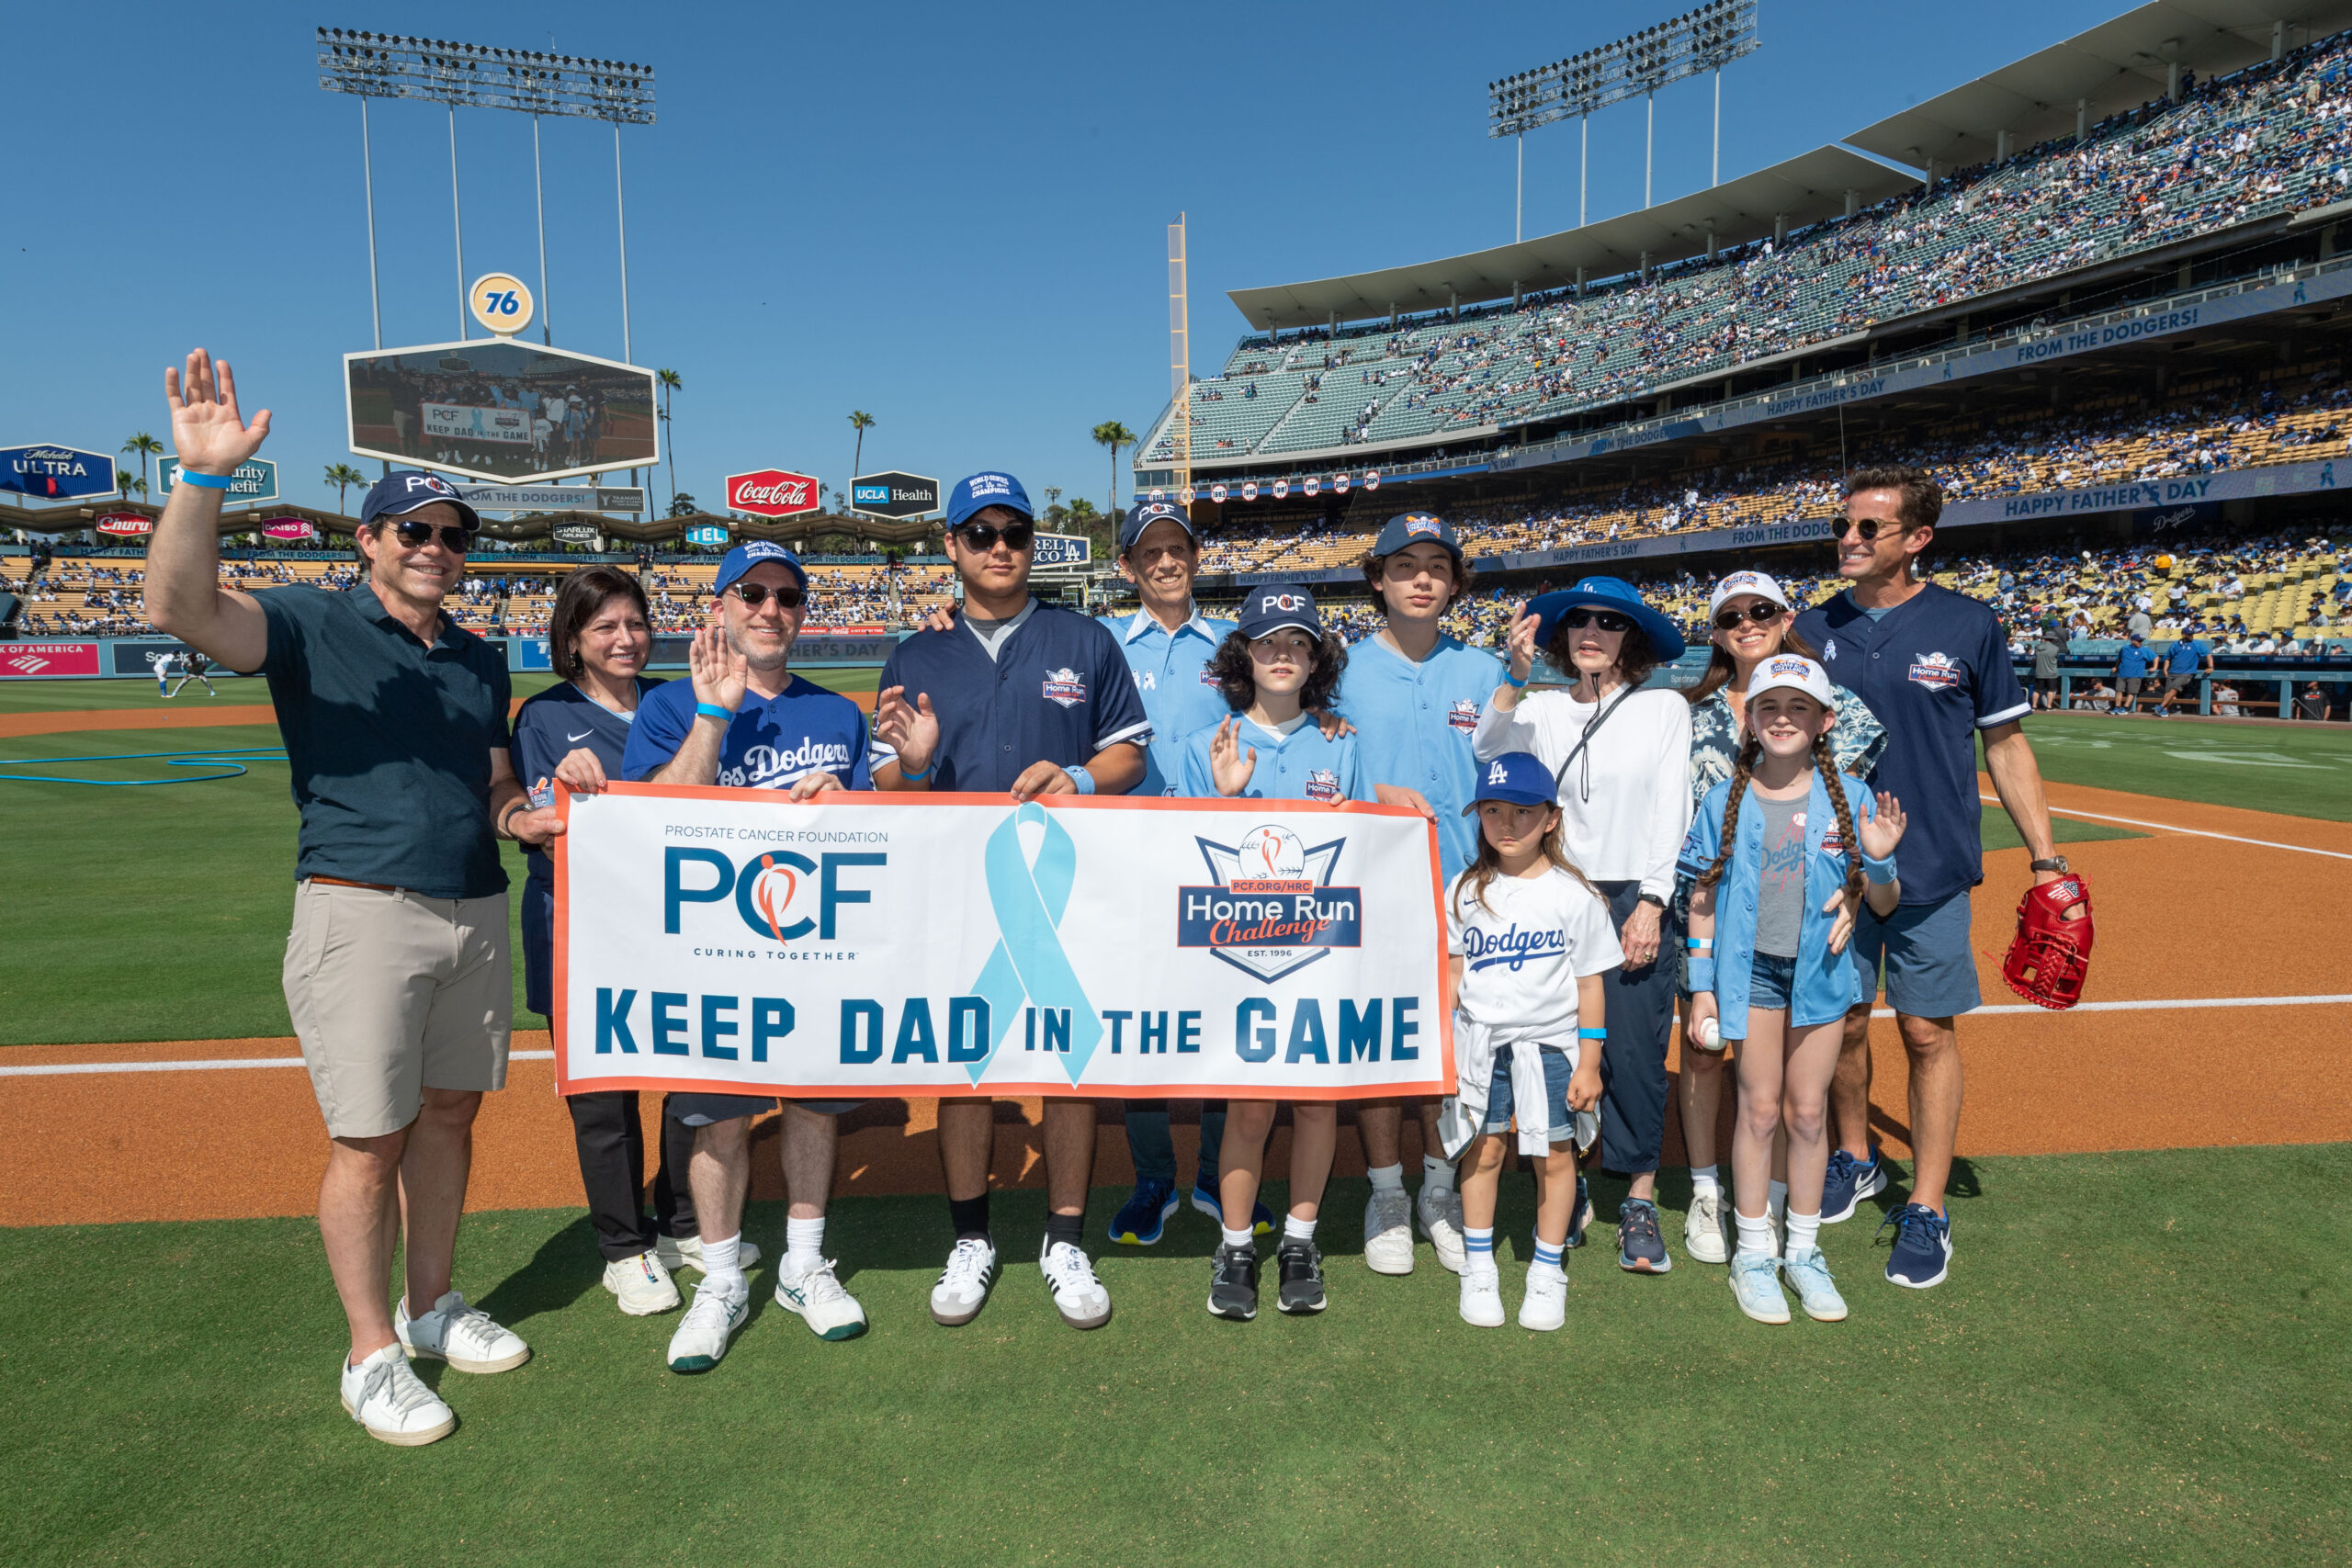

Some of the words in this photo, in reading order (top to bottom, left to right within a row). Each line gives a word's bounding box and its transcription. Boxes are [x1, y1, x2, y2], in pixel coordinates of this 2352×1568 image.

[485, 290, 521, 316] 76
[2018, 340, 2063, 362] FROM
[2067, 330, 2098, 350] THE
[2103, 309, 2199, 342] DODGERS!
[1767, 397, 1804, 416] HAPPY
[1805, 386, 1858, 408] FATHER'S
[1860, 379, 1885, 395] DAY
[433, 409, 459, 422] PCF
[426, 423, 450, 434] KEEP
[454, 427, 474, 437] DAD
[503, 431, 529, 441] GAME
[24, 449, 74, 460] Michelob
[13, 460, 87, 477] ULTRA
[232, 466, 266, 482] urity
[226, 480, 260, 493] nefit
[405, 476, 456, 497] PCF
[969, 475, 989, 488] WORLD
[1335, 479, 1349, 489] 2020
[735, 479, 810, 506] Coca-Cola
[857, 489, 887, 501] UCLA
[892, 489, 933, 502] Health
[972, 487, 1011, 499] CHAMPIONS
[1274, 485, 1287, 494] 1981
[495, 492, 518, 502] THE
[521, 492, 585, 504] DODGERS!
[2005, 495, 2065, 517] HAPPY
[2071, 483, 2160, 510] FATHER'S
[2166, 479, 2212, 500] DAY
[1137, 502, 1175, 522] PCF
[2154, 505, 2196, 533] Dodgers
[99, 516, 151, 531] Churu
[265, 524, 298, 532] DAISO
[691, 527, 724, 542] TEL
[1733, 530, 1766, 545] FROM
[1768, 526, 1790, 541] THE
[1793, 522, 1830, 537] DODG
[81, 547, 115, 556] HAPPY
[247, 550, 275, 559] FROM
[278, 551, 295, 559] THE
[297, 550, 346, 559] DODGERS!
[1064, 539, 1080, 562] LA
[1553, 548, 1580, 563] HAPPY
[1581, 546, 1619, 560] FATHER'S
[1621, 543, 1640, 556] DAY
[558, 554, 602, 563] DODGERS!
[840, 556, 879, 564] DODGERS!
[1240, 574, 1268, 584] HAPPY
[1310, 570, 1329, 581] DAY
[1261, 592, 1306, 615] PCF
[26, 645, 84, 653] AMERICA
[845, 642, 879, 657] DAY
[1912, 667, 1940, 677] Home
[1940, 670, 1958, 680] Run
[1046, 683, 1070, 692] Home
[744, 736, 851, 783] Dodgers
[1487, 760, 1509, 785] LA
[1307, 783, 1330, 794] Home
[664, 824, 735, 840] PROSTATE
[739, 828, 795, 843] CANCER
[798, 829, 888, 844] FOUNDATION
[1760, 840, 1804, 872] Dodg
[664, 845, 888, 943] PCF
[1232, 881, 1311, 893] PCF.ORG/HRC
[1187, 894, 1283, 921] Home
[1294, 895, 1355, 922] Run
[1209, 917, 1331, 946] Challenge
[694, 947, 757, 959] CURING
[1463, 922, 1566, 973] Dodgers
[594, 986, 797, 1063] KEEP
[839, 994, 991, 1065] DAD
[1024, 1006, 1073, 1054] IN
[1102, 1010, 1202, 1055] THE
[1235, 996, 1419, 1065] GAME
